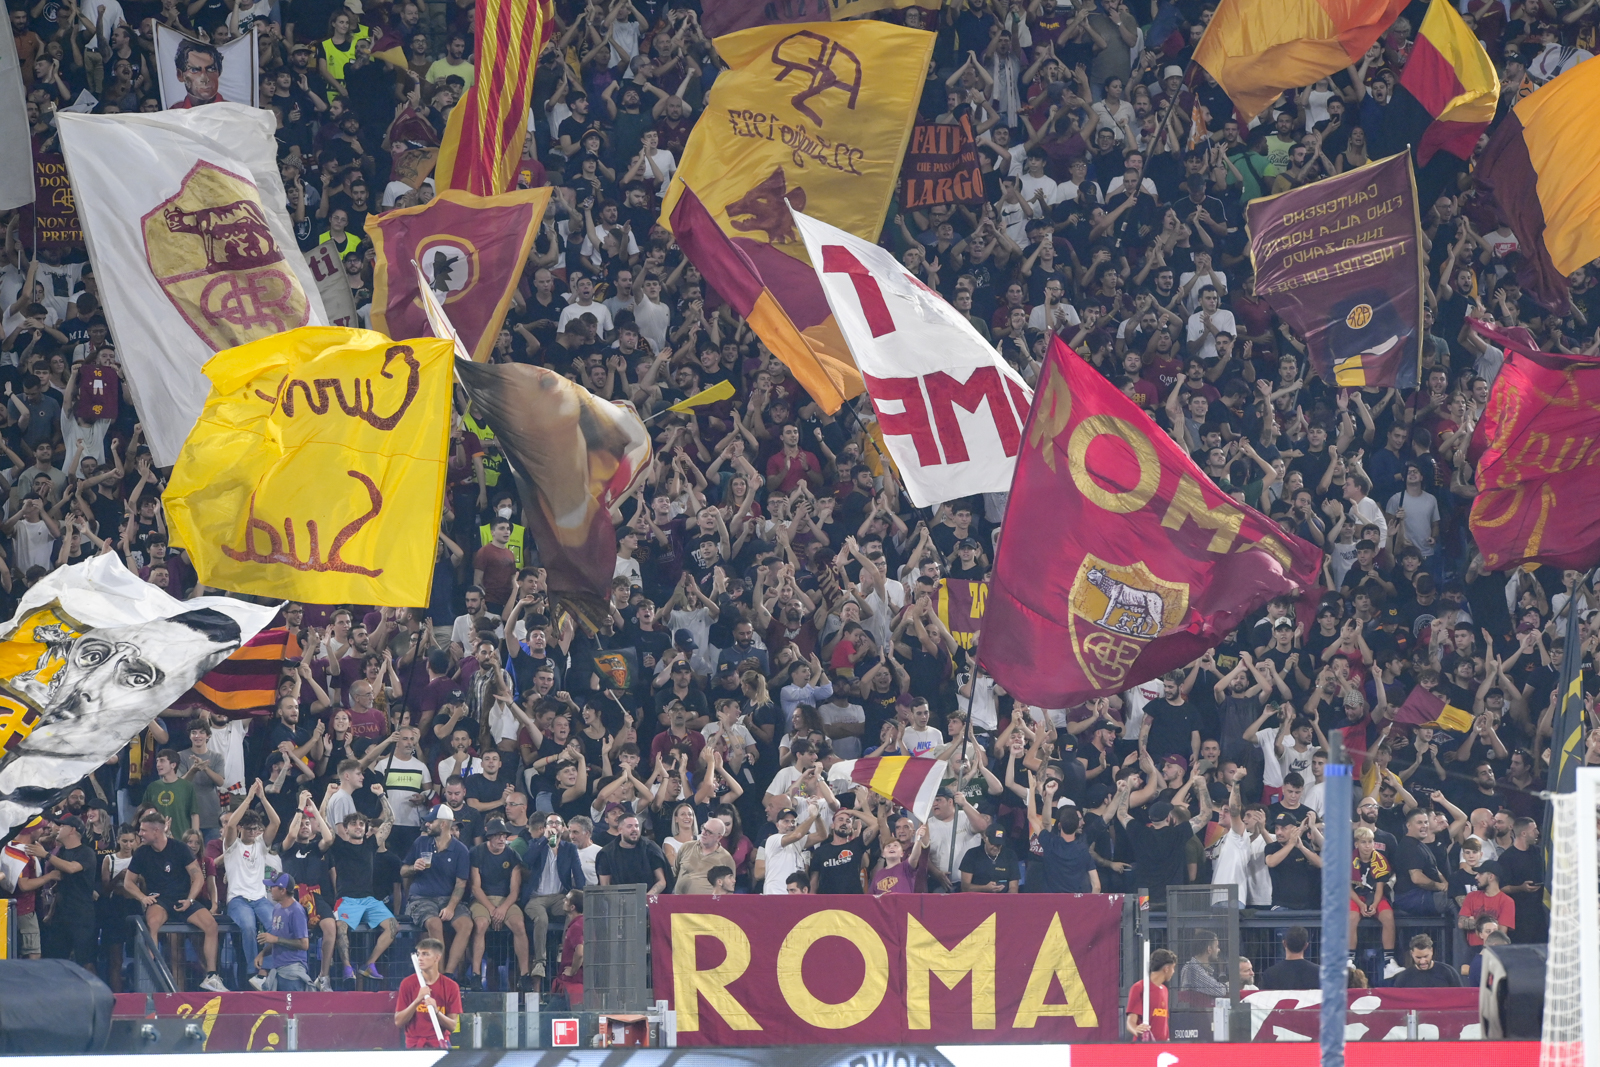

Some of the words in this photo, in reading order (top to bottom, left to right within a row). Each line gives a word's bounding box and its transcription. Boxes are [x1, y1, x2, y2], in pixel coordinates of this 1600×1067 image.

[906, 167, 984, 208] LARGO
[1160, 374, 1178, 383] QATA
[917, 741, 932, 750] NIKE
[671, 908, 1099, 1032] ROMA
